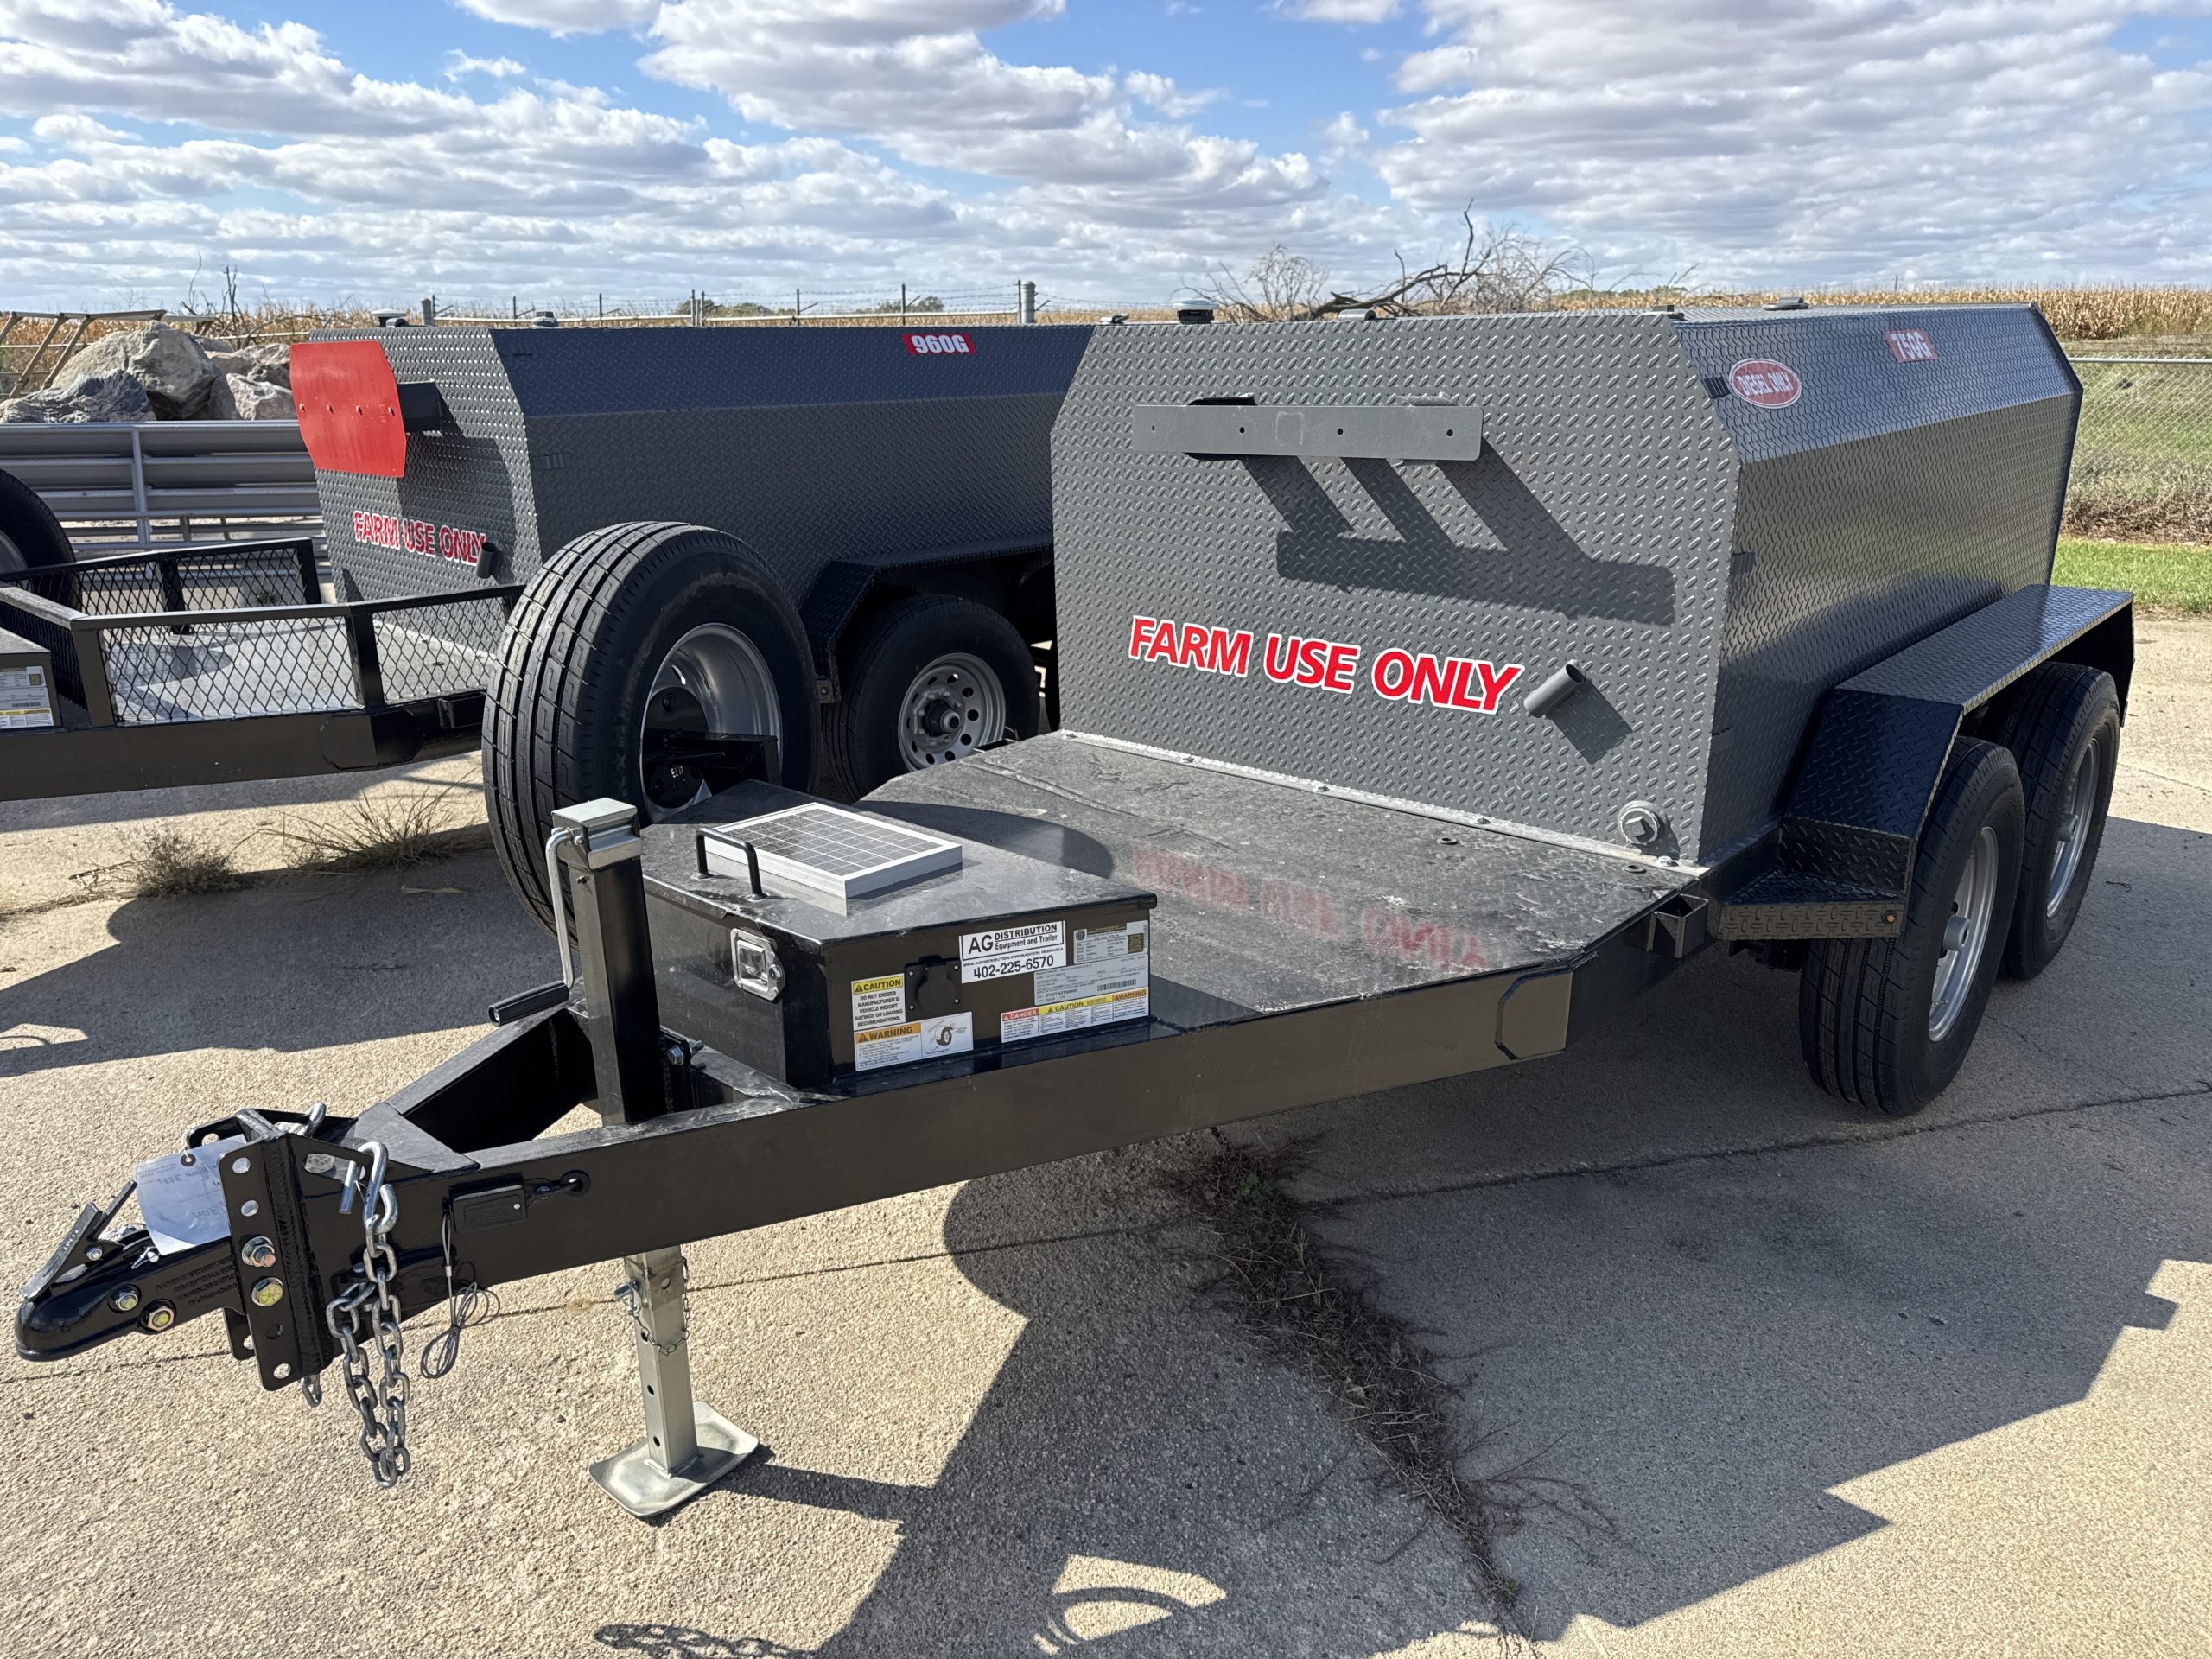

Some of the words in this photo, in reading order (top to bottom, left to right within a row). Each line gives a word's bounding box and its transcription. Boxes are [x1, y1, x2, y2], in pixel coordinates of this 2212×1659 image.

[1736, 373, 1773, 396] DIESEL
[1767, 372, 1794, 392] ONLY
[353, 511, 401, 550] FARM
[403, 518, 436, 557] USE
[439, 524, 486, 567] ONLY
[1128, 615, 1254, 677] FARM
[1263, 633, 1360, 694] USE
[1371, 647, 1526, 715] ONLY
[995, 924, 1058, 940] DISTRIBUTION
[969, 934, 994, 955] AG
[995, 939, 1026, 950] Equipment
[1027, 937, 1038, 945] and
[1039, 934, 1058, 944] Trailer
[974, 955, 1054, 979] 402-225-6570
[863, 978, 901, 991] CAUTION
[1055, 1001, 1084, 1011] CAUTION
[1117, 989, 1147, 1000] WARNING
[855, 1013, 874, 1021] RATINGS
[883, 1008, 903, 1017] LOADING
[1010, 1009, 1037, 1019] DANGER
[869, 1027, 913, 1039] WARNING
